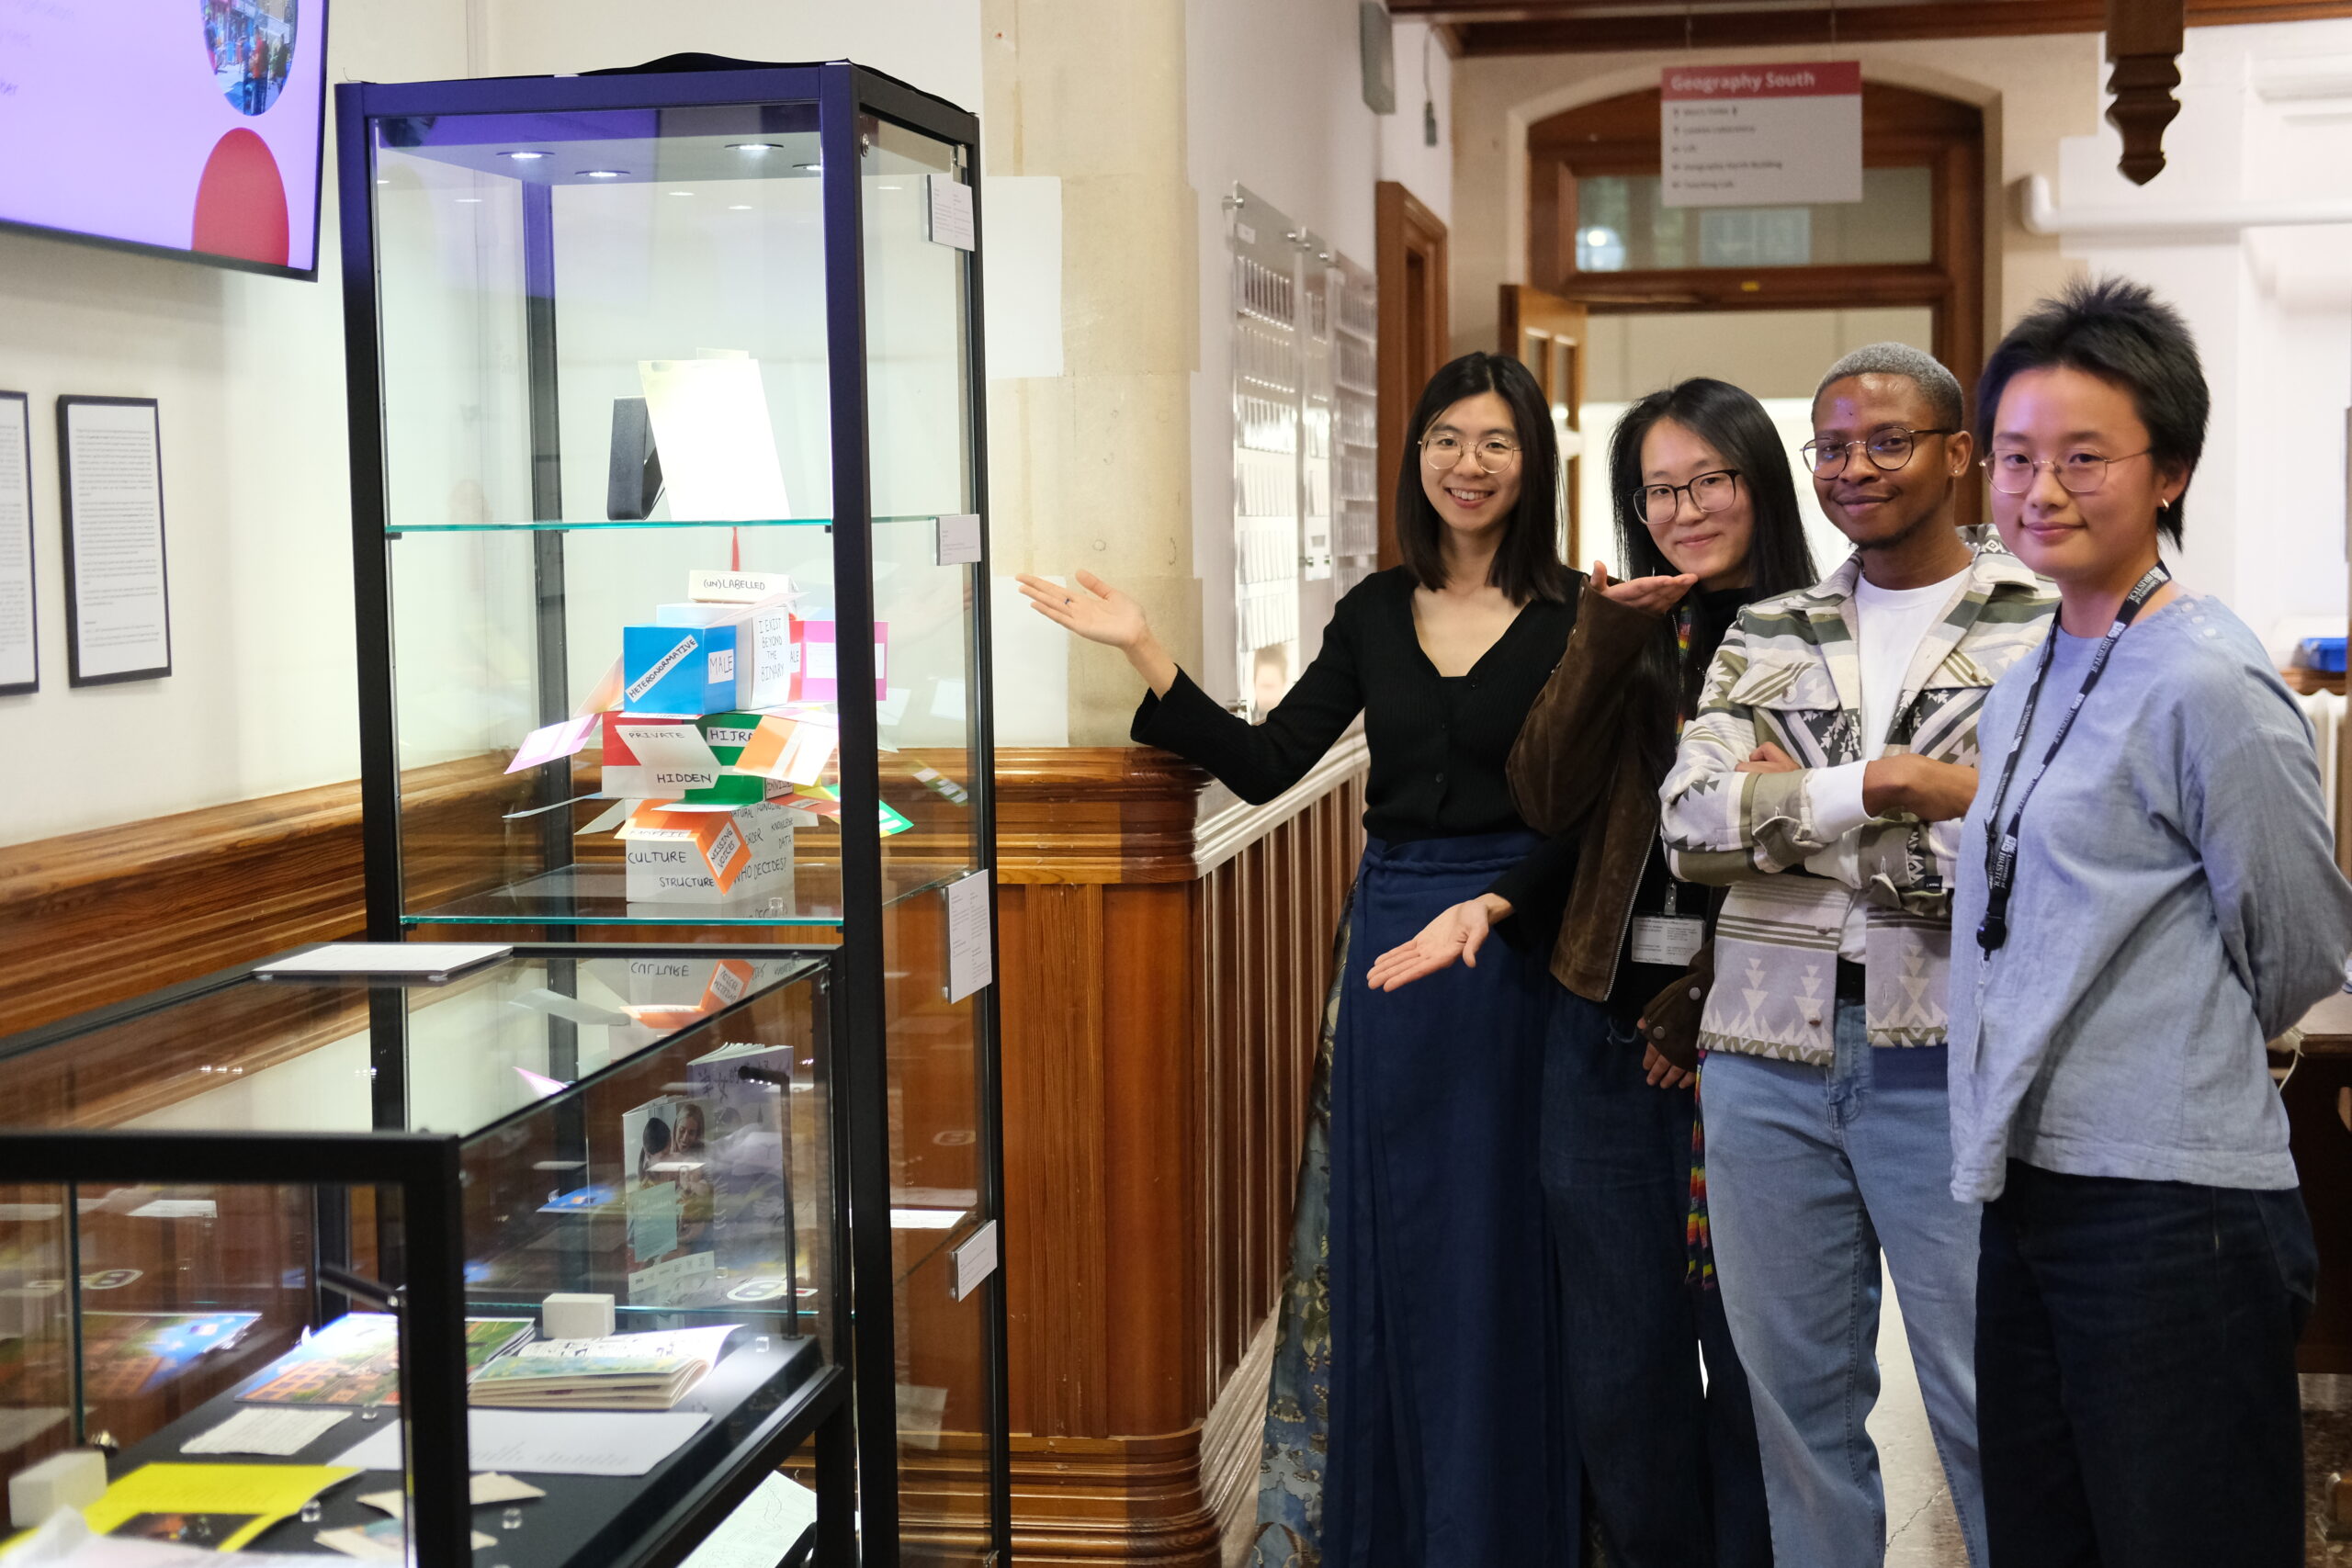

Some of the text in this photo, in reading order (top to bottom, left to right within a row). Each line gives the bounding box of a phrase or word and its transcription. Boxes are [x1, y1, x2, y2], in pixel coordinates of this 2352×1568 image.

[1670, 71, 1815, 94] Geography South
[2127, 572, 2154, 602] BRISTOL
[764, 617, 782, 632] EXIST
[762, 635, 783, 649] BEYOND
[766, 650, 777, 660] THE
[628, 638, 696, 698] HETERONORMATIVE
[709, 655, 733, 676] MALE
[761, 662, 785, 682] BINARY
[628, 731, 686, 739] PRIVATE
[656, 773, 712, 784] HIDDEN
[710, 828, 733, 861] MISSING
[778, 834, 792, 850] DATA
[628, 851, 687, 864] CULTURE
[717, 840, 735, 868] VOICES
[1994, 852, 2007, 887] BRISTOL
[659, 876, 716, 888] STRUCTURE
